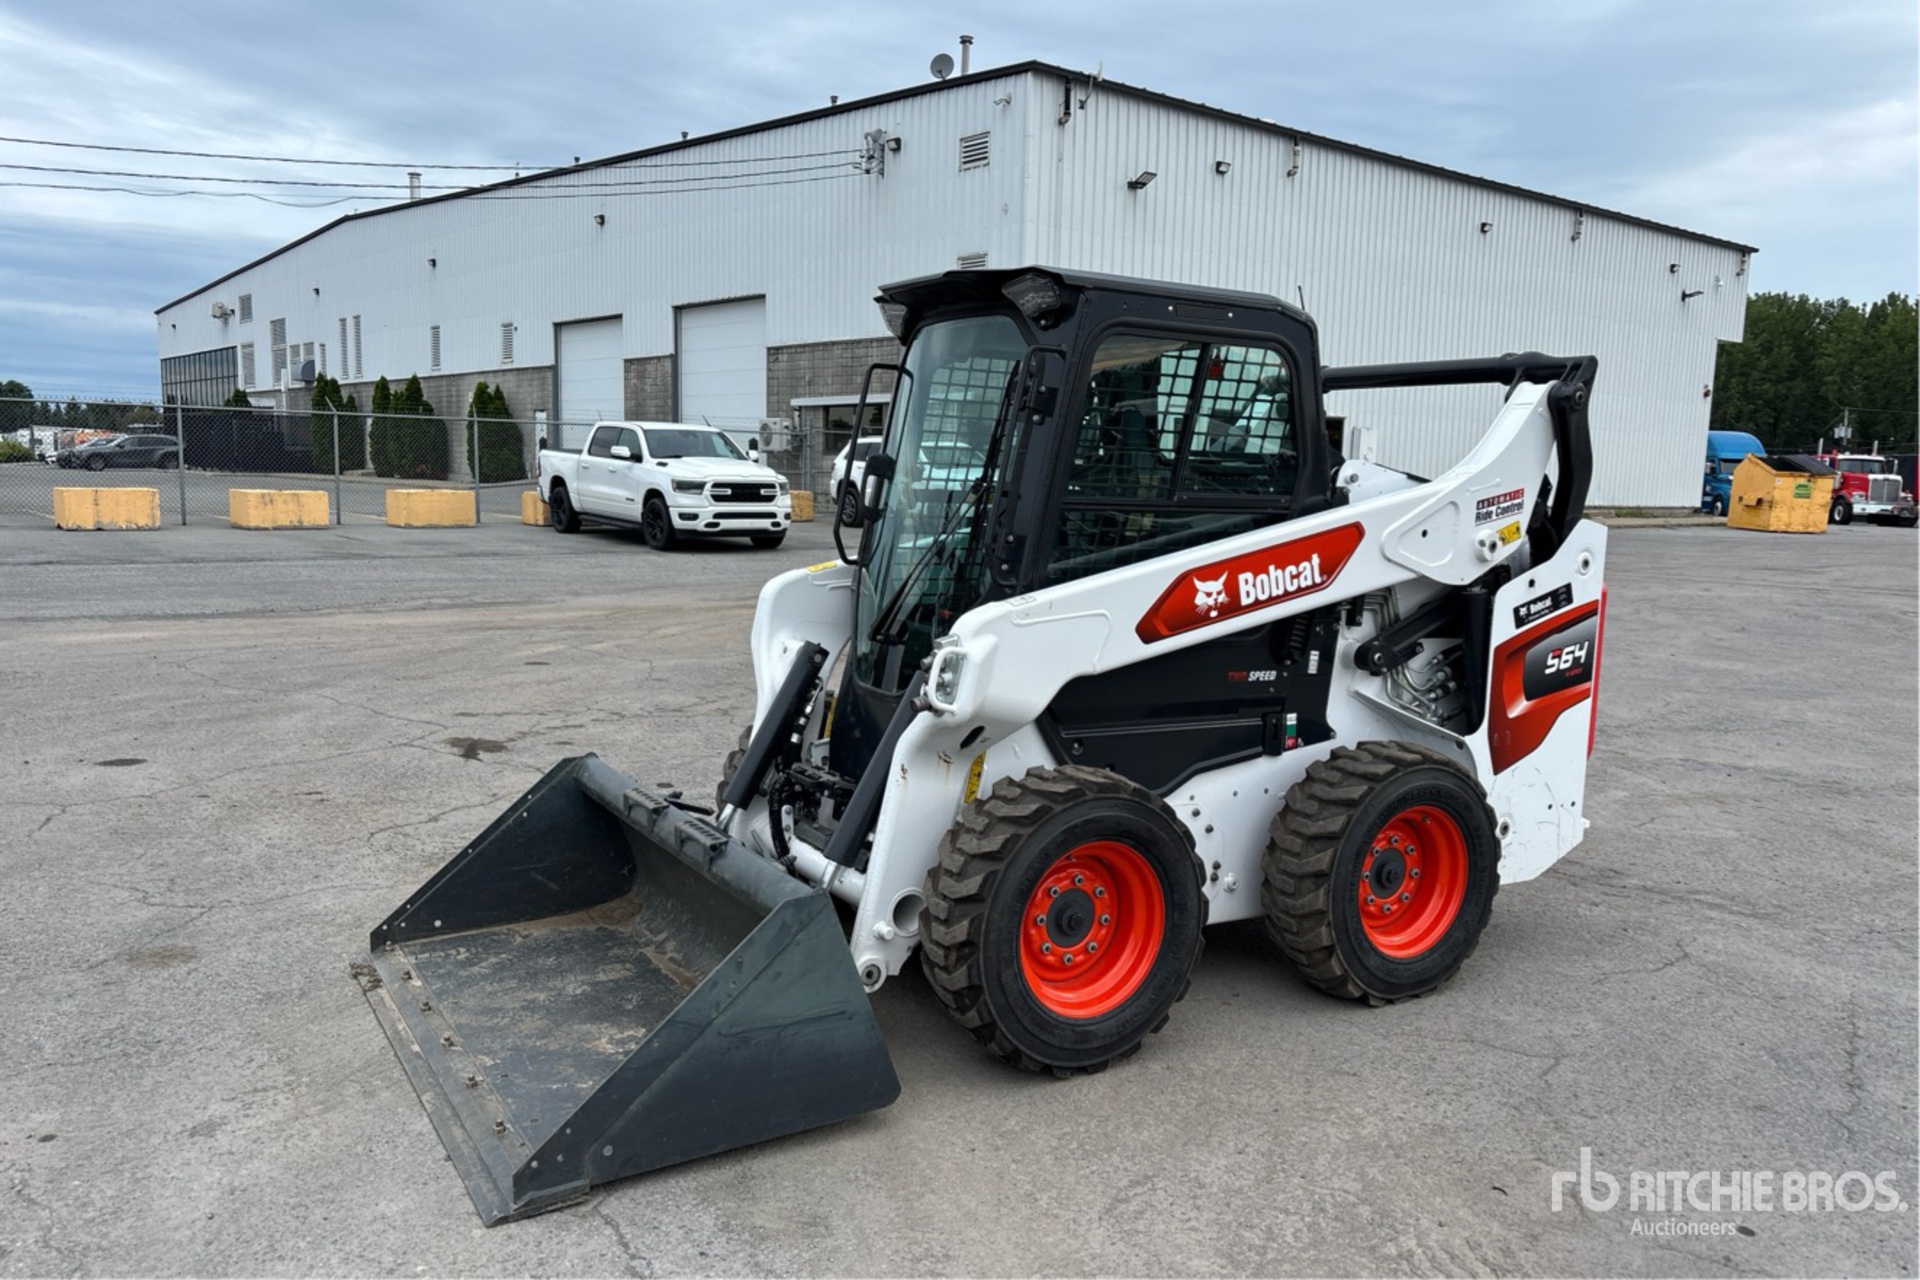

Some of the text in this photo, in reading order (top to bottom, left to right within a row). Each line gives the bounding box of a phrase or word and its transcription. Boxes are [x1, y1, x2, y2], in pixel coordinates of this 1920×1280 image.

[1477, 489, 1524, 509] AUTOMATIC
[1475, 499, 1524, 523] Ride Control
[1238, 553, 1322, 606] Bobcat
[1530, 597, 1552, 614] Bobcat
[1544, 641, 1589, 674] S64
[1248, 670, 1277, 681] SPEED
